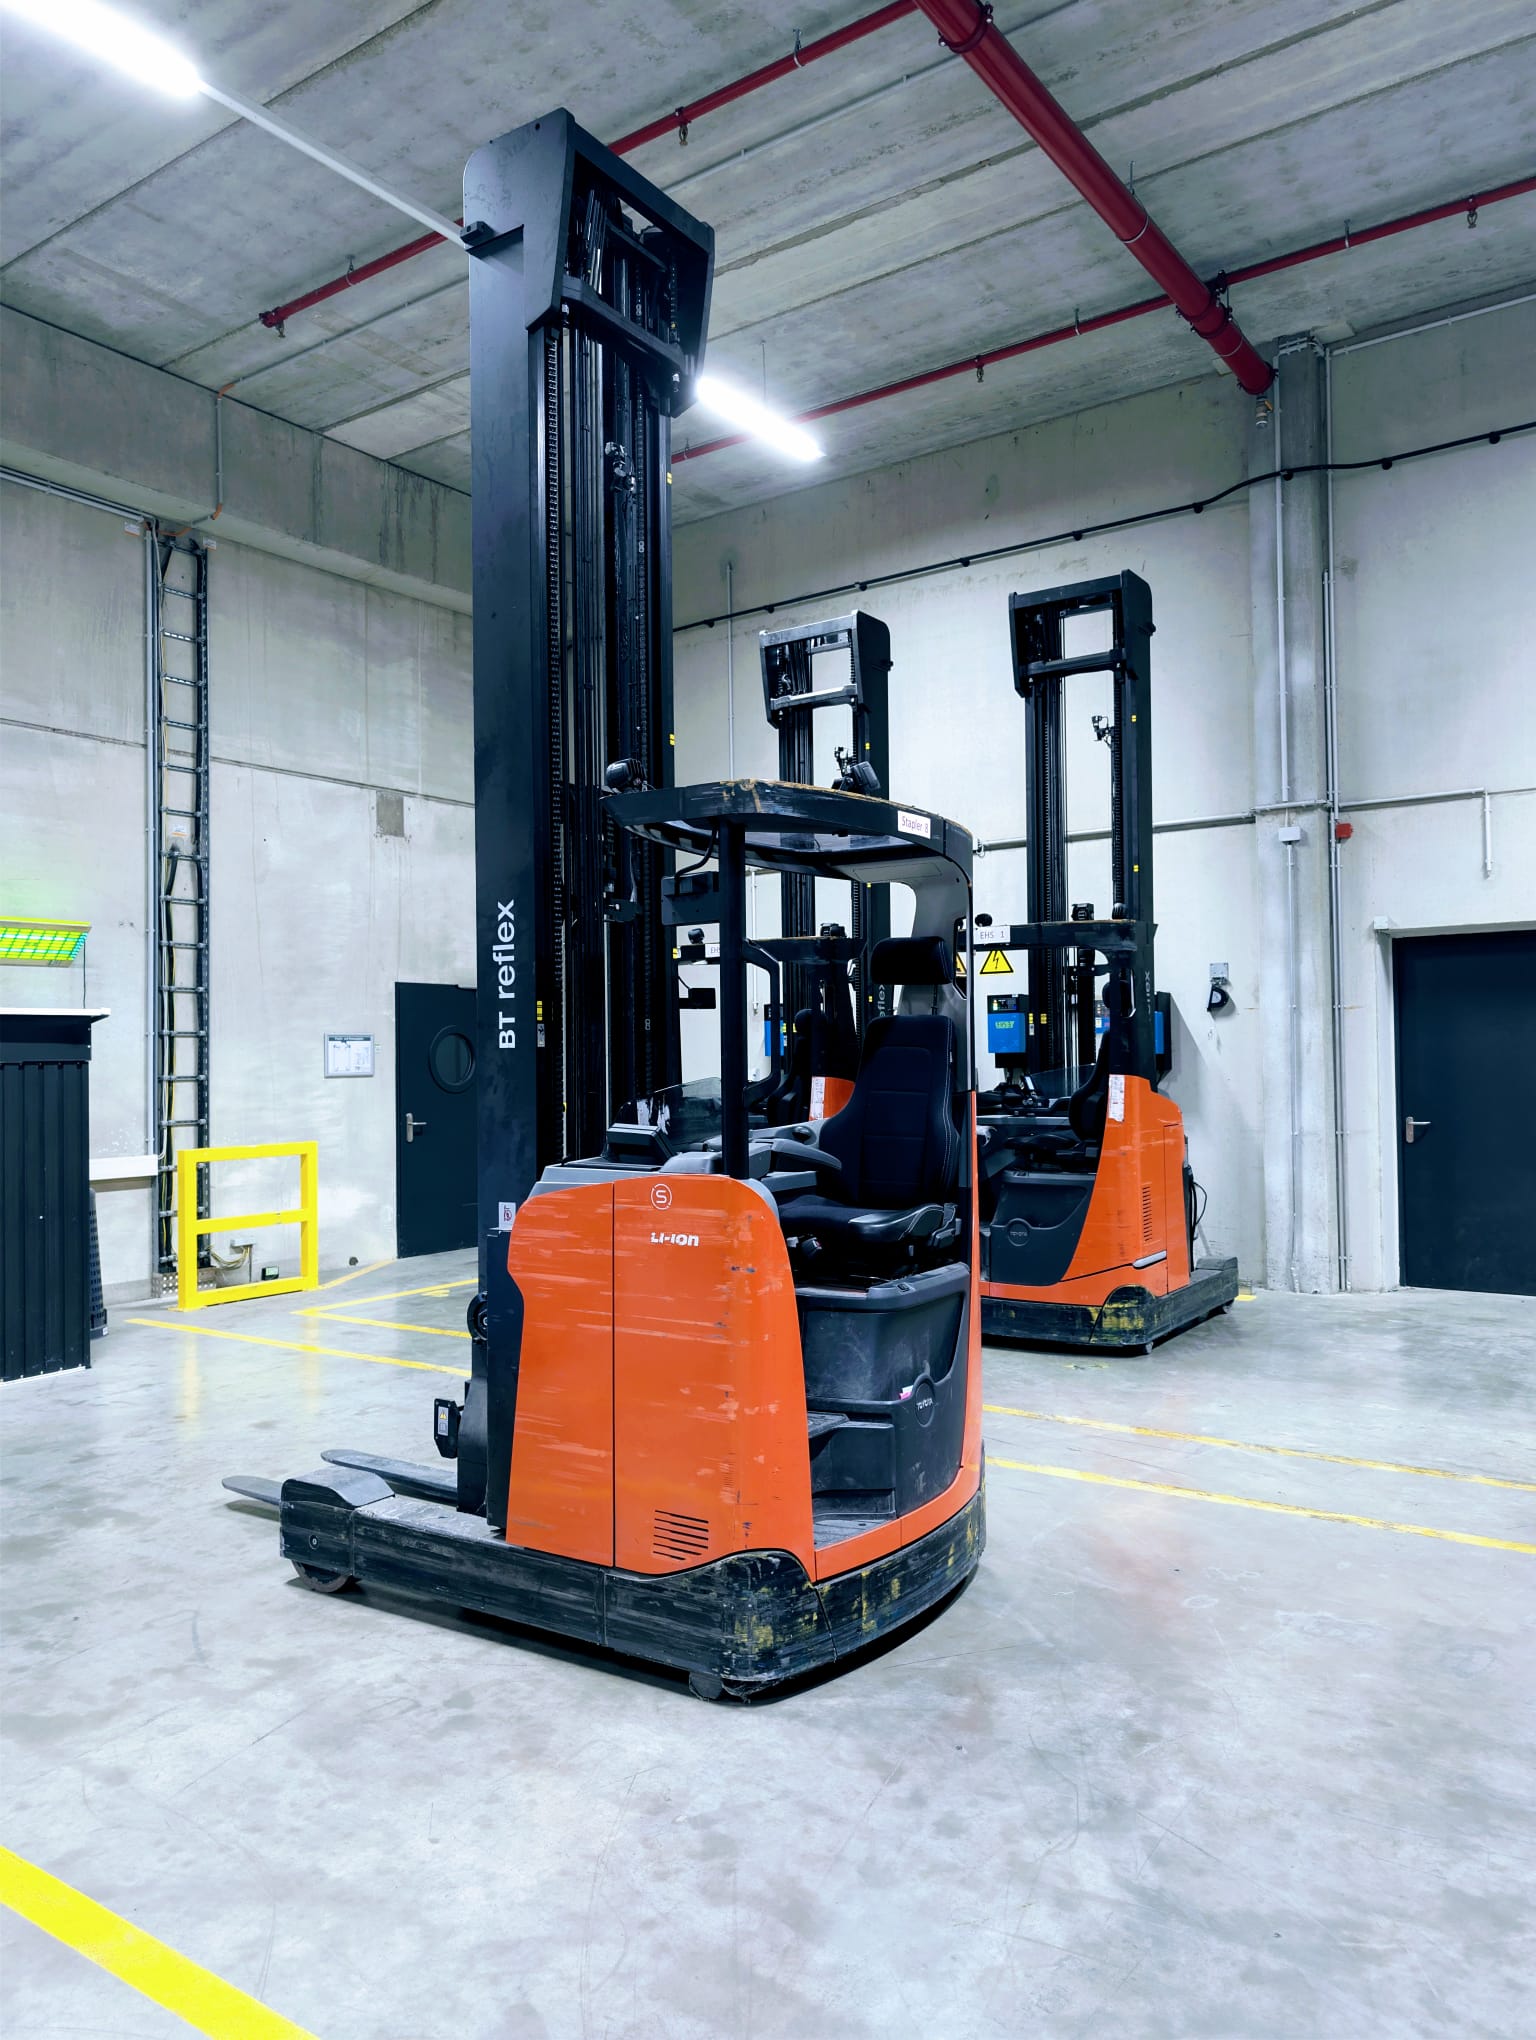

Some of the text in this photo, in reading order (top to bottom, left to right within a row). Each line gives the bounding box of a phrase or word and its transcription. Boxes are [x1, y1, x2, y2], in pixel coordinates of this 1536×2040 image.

[902, 816, 929, 834] Stapler 8
[980, 930, 1005, 940] EHS 1
[492, 899, 516, 1049] BT reflex
[655, 1189, 668, 1204] S
[916, 1398, 934, 1411] TOYOTA
